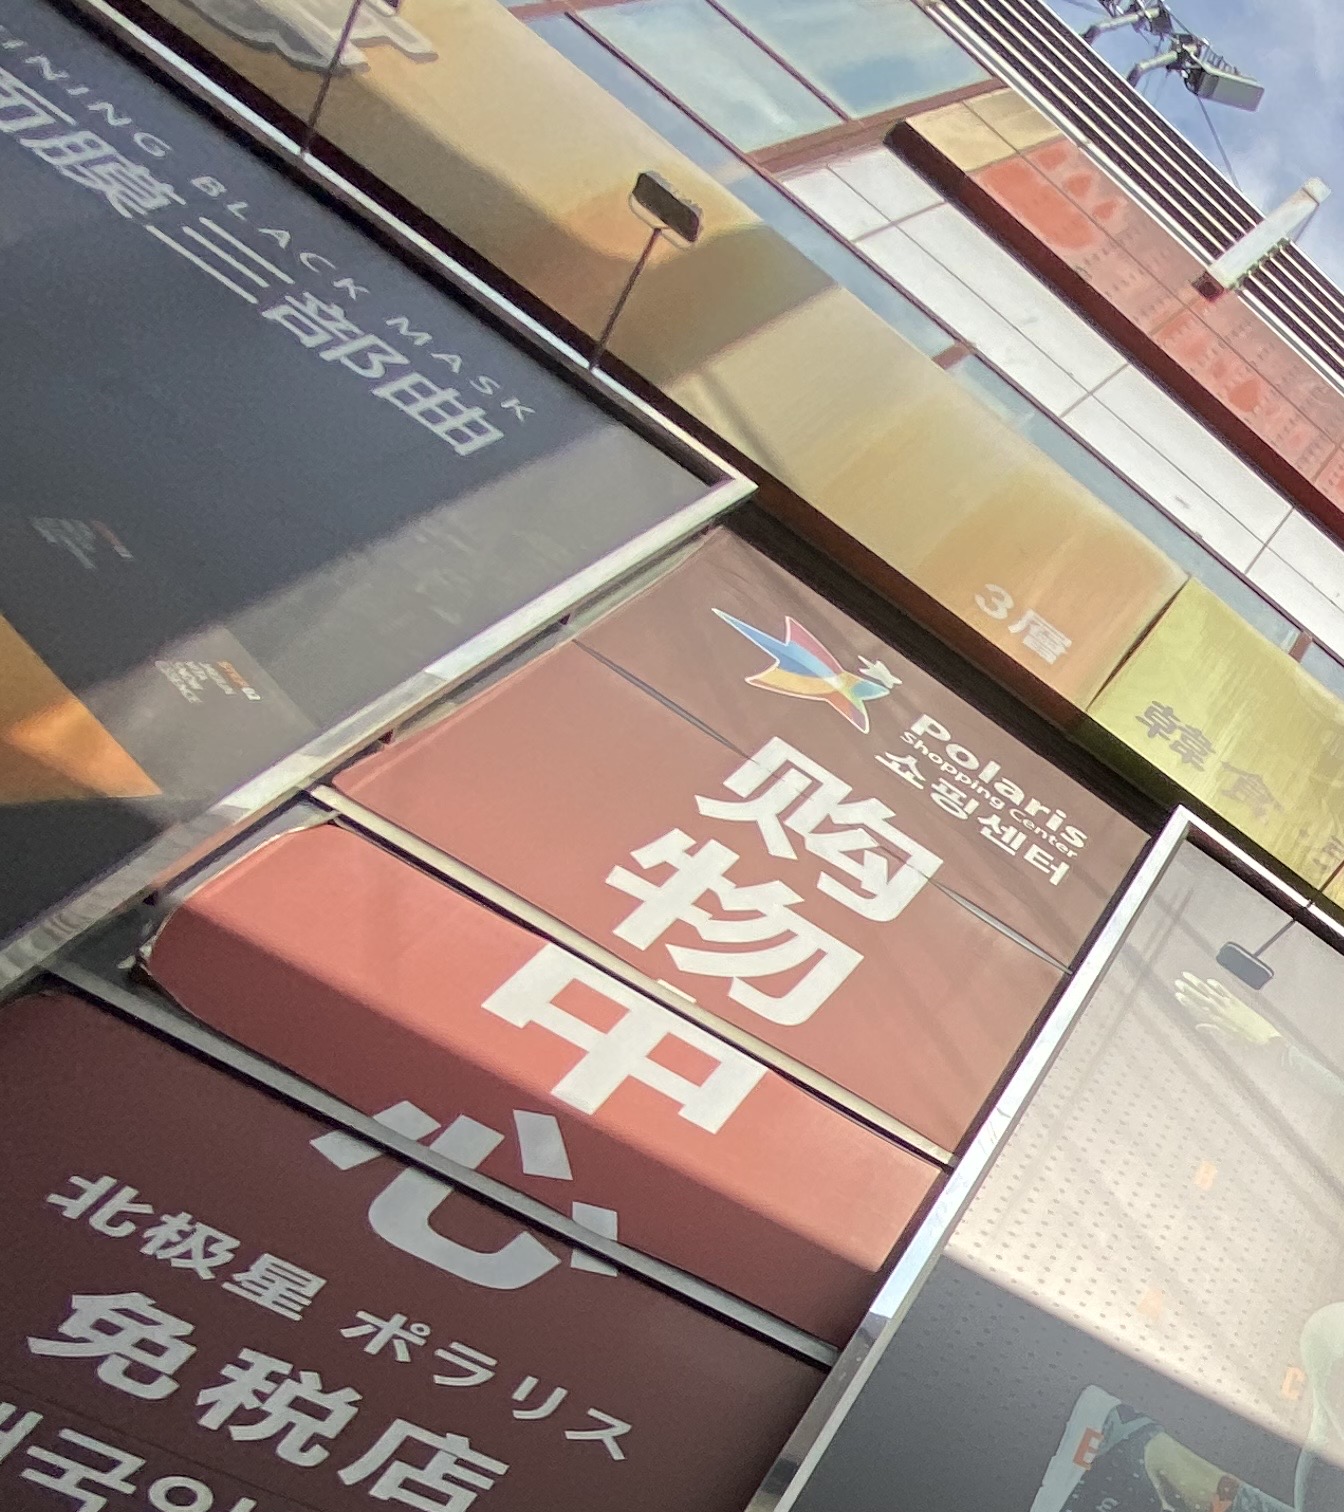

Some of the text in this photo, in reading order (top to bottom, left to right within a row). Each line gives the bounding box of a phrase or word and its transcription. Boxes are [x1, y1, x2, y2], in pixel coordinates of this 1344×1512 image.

[0, 25, 537, 422] INING BLACK MASK
[875, 744, 1070, 887] 쇼핑센터
[900, 730, 1079, 860] Shopping Center
[903, 712, 1088, 851] Polaris
[45, 1175, 632, 1462] 北极星 ポラリス
